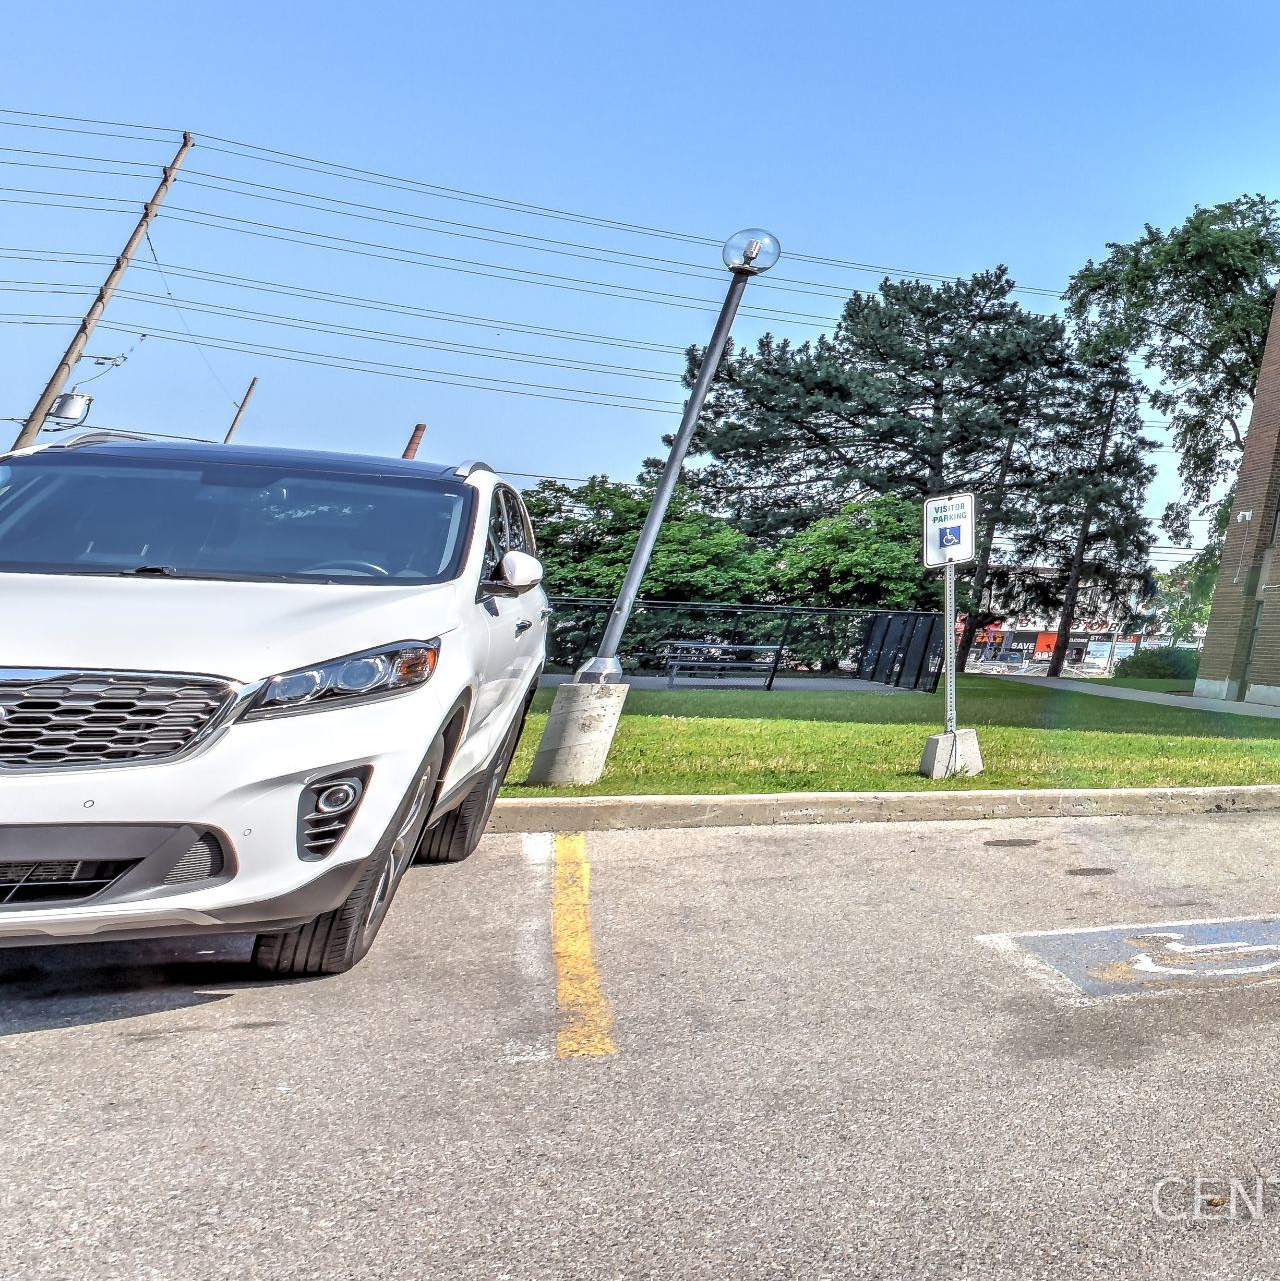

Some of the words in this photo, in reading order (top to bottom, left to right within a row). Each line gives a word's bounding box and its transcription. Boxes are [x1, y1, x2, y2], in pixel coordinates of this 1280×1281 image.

[934, 503, 965, 513] VISITOR
[933, 512, 966, 523] PARKING
[1011, 642, 1035, 650] SAVE
